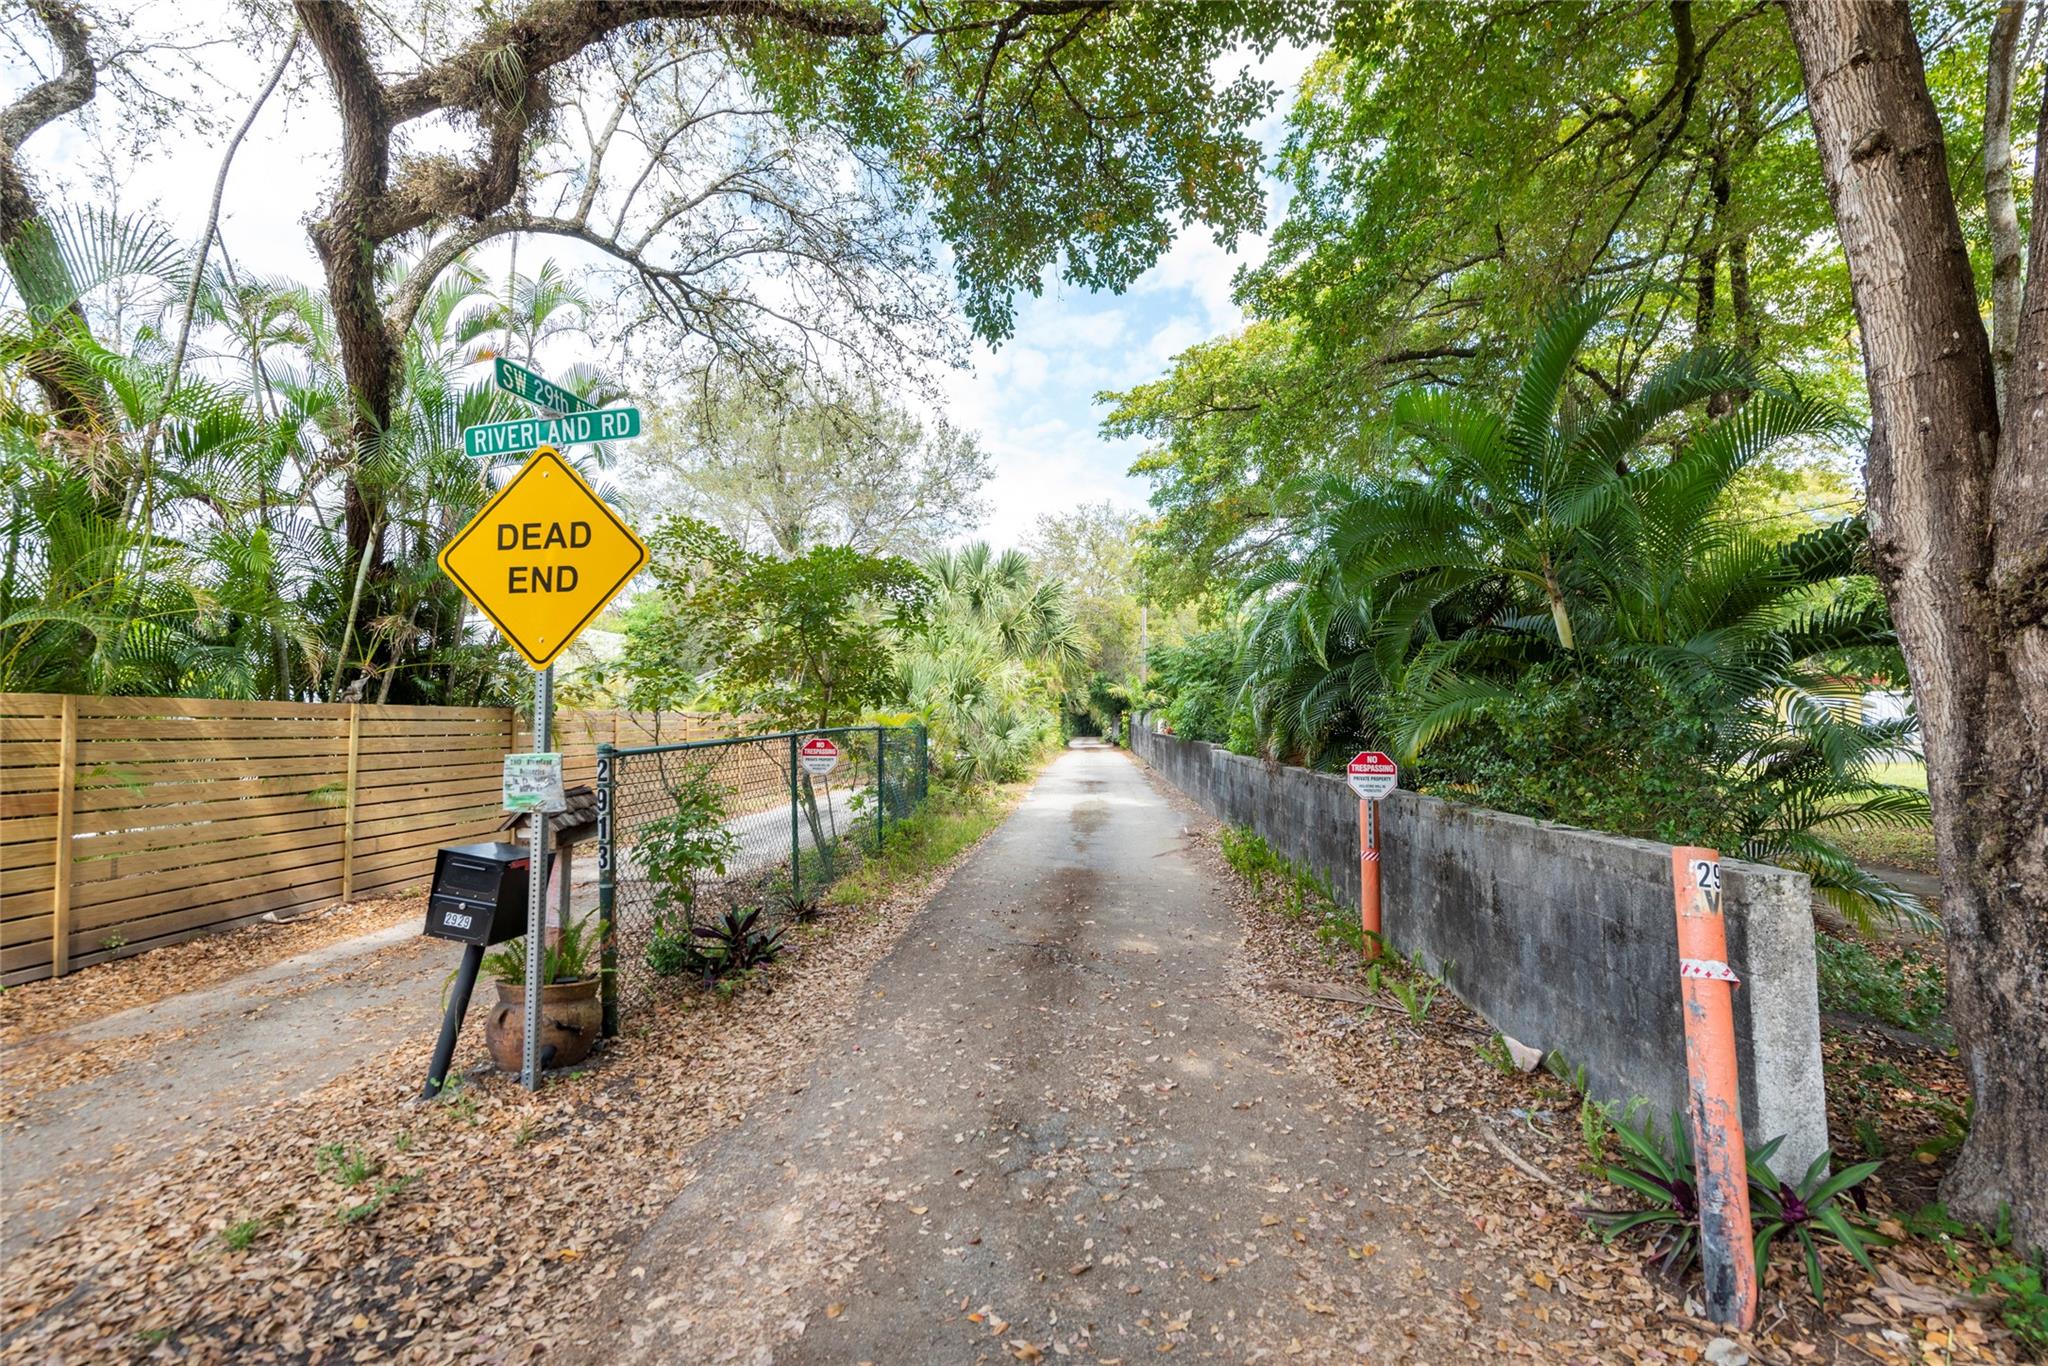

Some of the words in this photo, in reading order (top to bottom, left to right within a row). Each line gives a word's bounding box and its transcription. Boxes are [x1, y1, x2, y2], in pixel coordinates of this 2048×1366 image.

[502, 364, 527, 395] SW
[534, 379, 569, 414] 29th
[474, 416, 591, 454] RIVERLAND
[601, 412, 630, 438] RD
[497, 521, 592, 551] DEAD
[508, 566, 579, 594] END
[1351, 764, 1394, 773] TRESPASSING
[1366, 755, 1378, 763] NO
[445, 914, 470, 928] 2929
